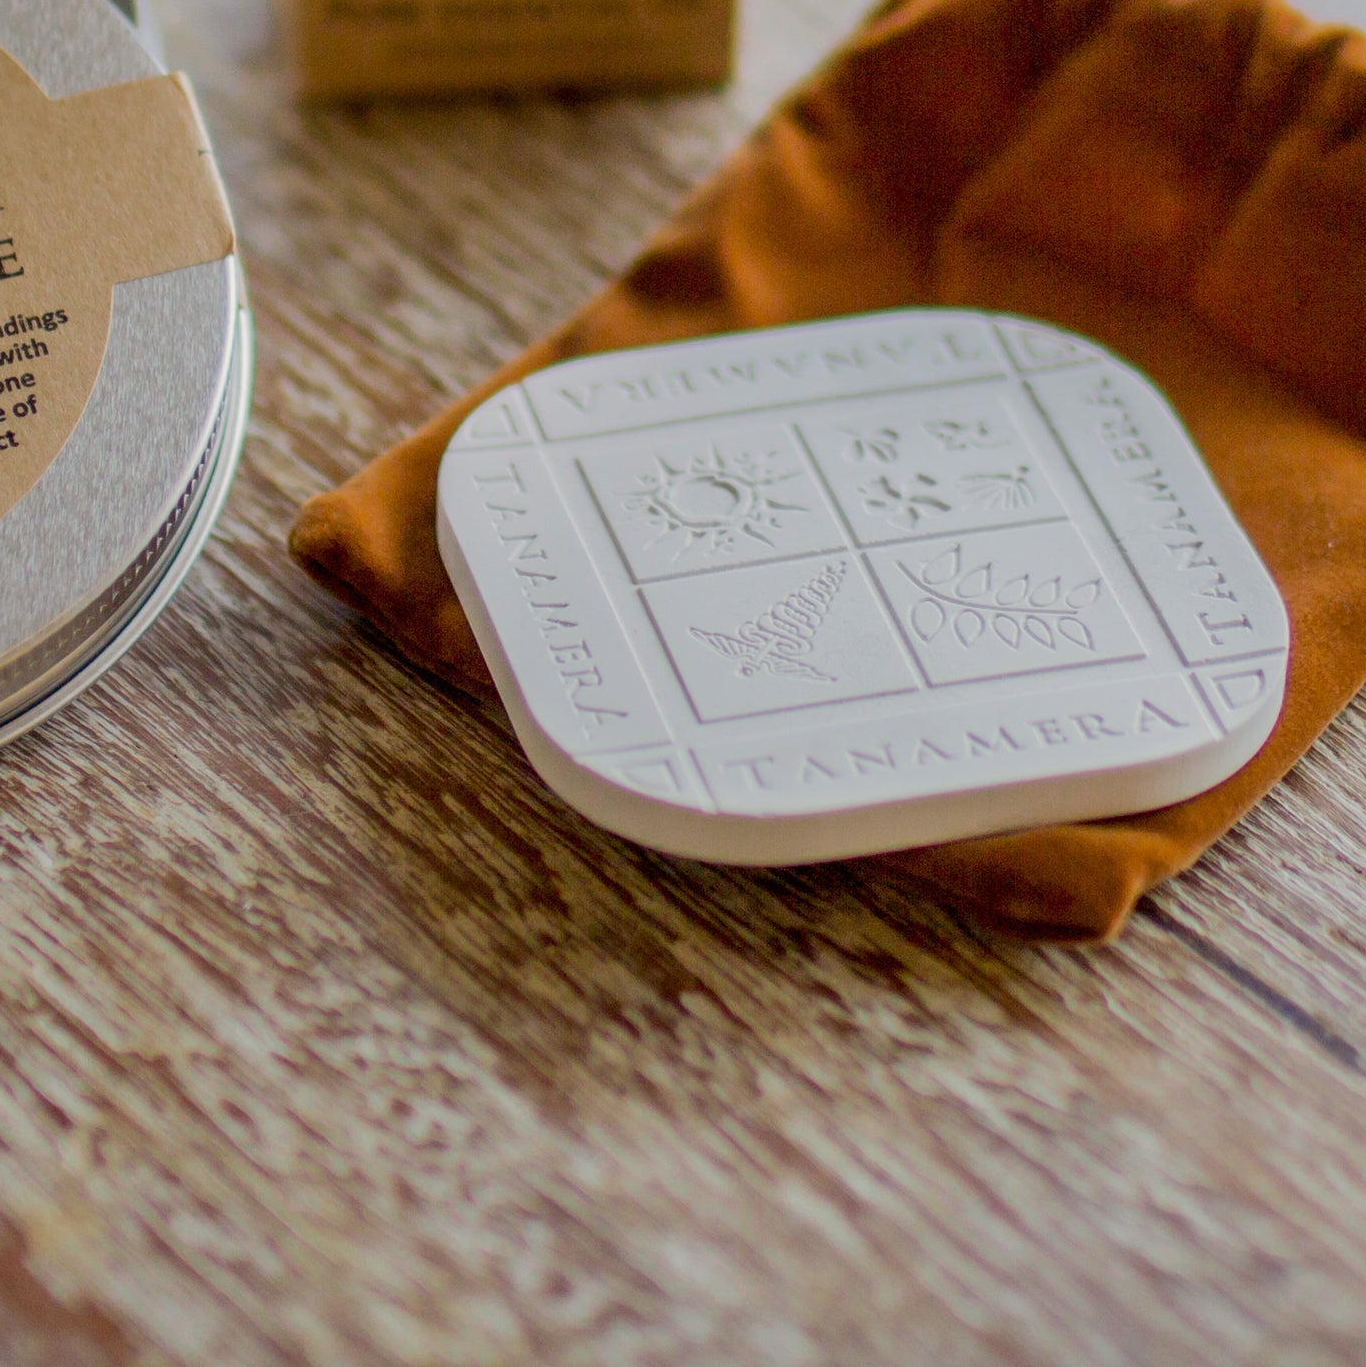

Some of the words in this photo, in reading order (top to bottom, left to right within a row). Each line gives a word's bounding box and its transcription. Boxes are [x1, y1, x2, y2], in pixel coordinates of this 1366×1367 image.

[12, 394, 38, 417] of
[473, 462, 629, 740] TANAMERA
[722, 699, 1190, 791] TANAMERA
